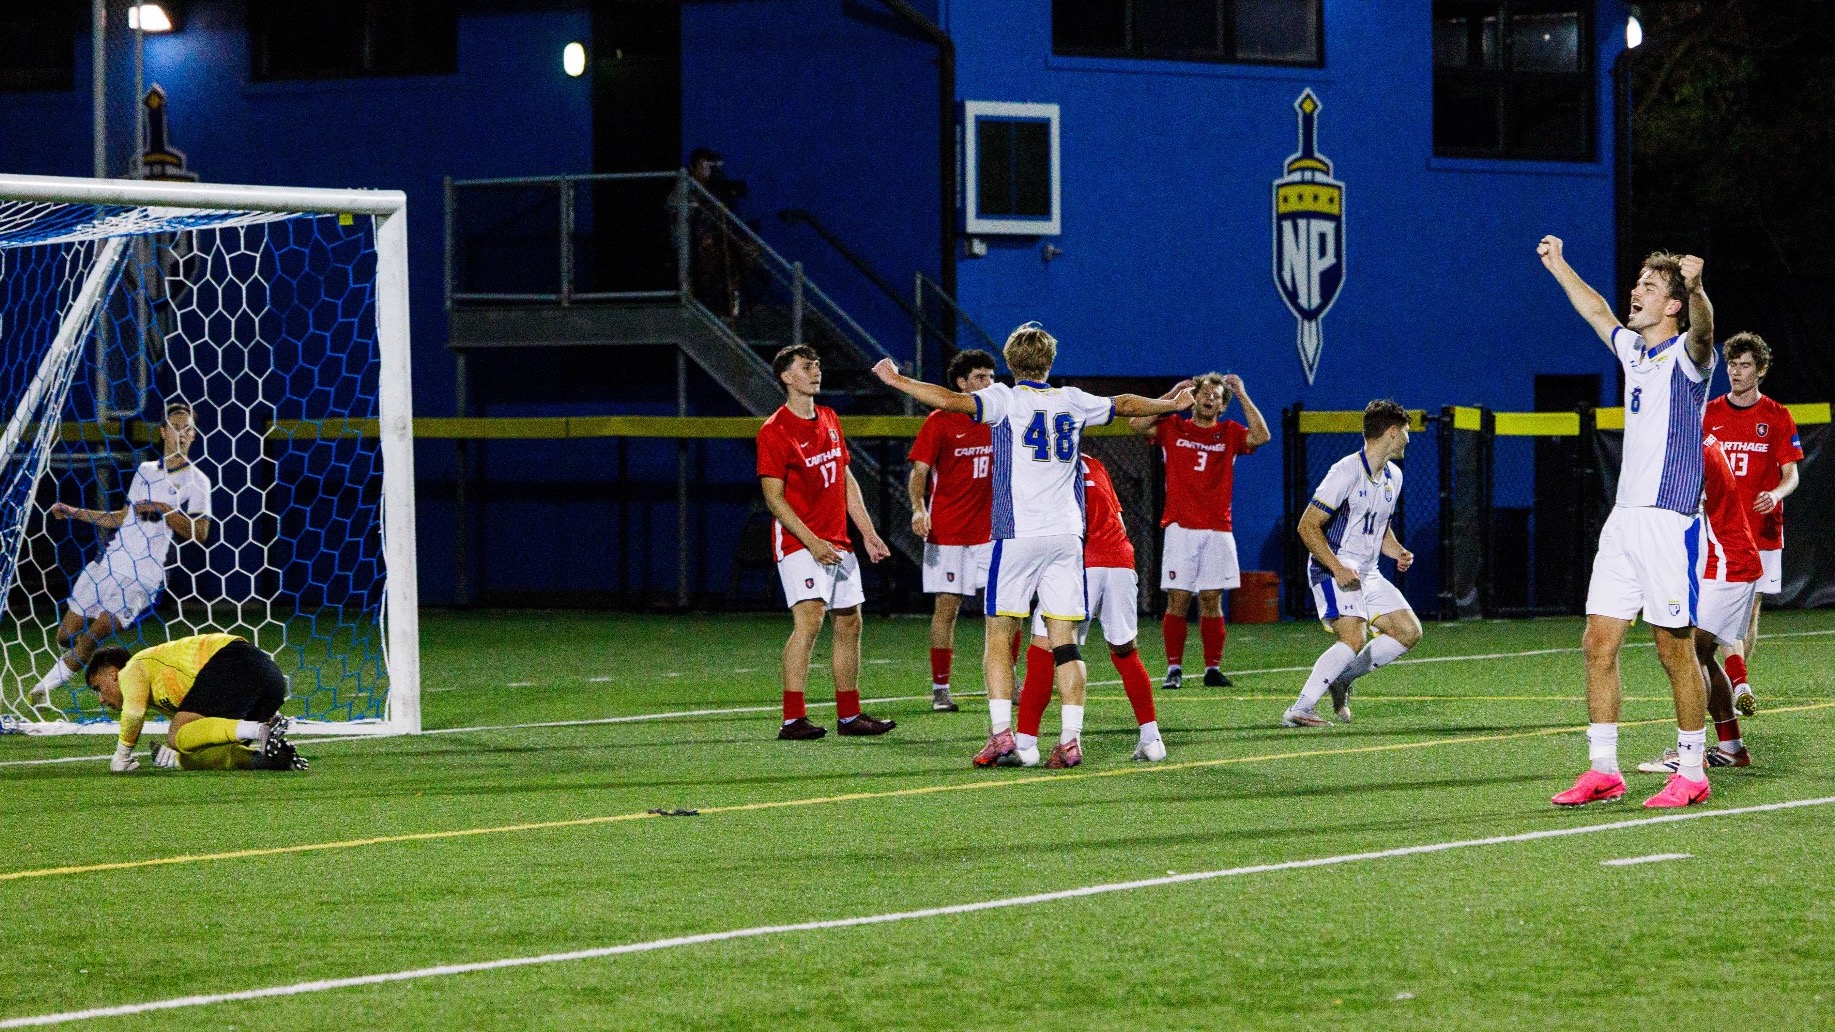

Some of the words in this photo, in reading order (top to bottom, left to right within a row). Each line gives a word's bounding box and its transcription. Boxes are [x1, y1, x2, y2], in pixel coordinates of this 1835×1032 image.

[1281, 218, 1337, 310] NP
[1631, 386, 1642, 414] 8
[1021, 409, 1075, 463] 48
[1176, 438, 1226, 452] CARTHAGE
[1720, 441, 1769, 453] RTHAGE
[820, 460, 837, 488] 17
[972, 456, 990, 479] 18
[1193, 451, 1208, 472] 3
[1729, 453, 1749, 477] 13
[1362, 508, 1377, 535] 11
